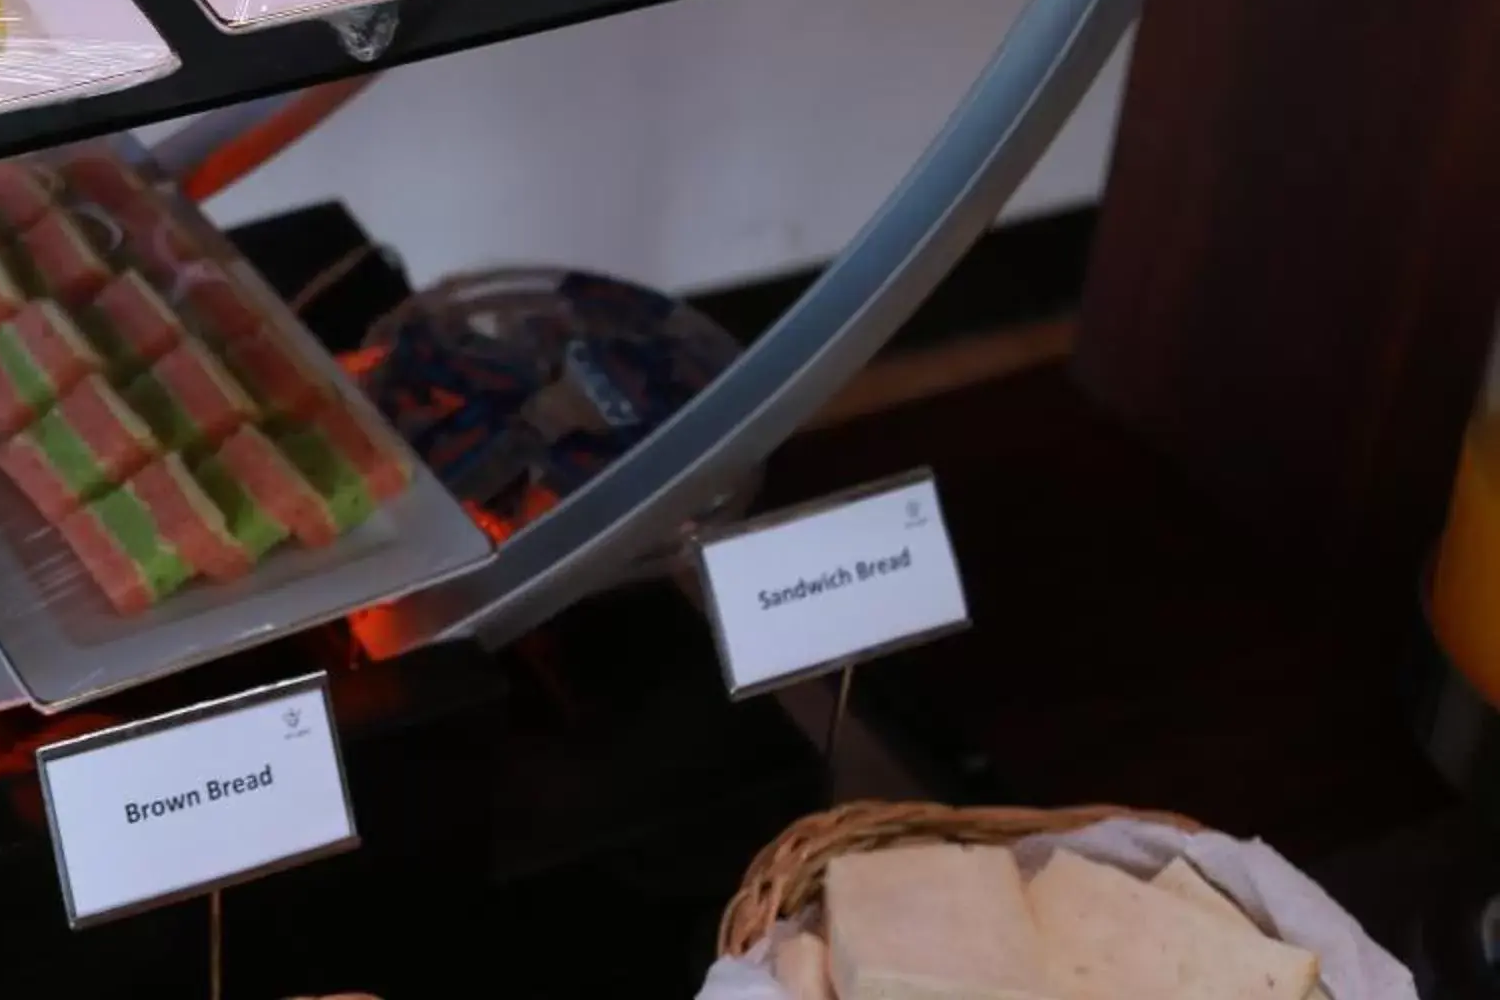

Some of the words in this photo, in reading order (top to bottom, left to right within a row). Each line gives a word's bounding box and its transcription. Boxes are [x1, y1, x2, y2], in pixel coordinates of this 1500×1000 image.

[758, 568, 852, 610] Sandwich
[855, 547, 911, 581] Bread
[125, 790, 200, 824] Brown
[206, 764, 273, 801] Bread
